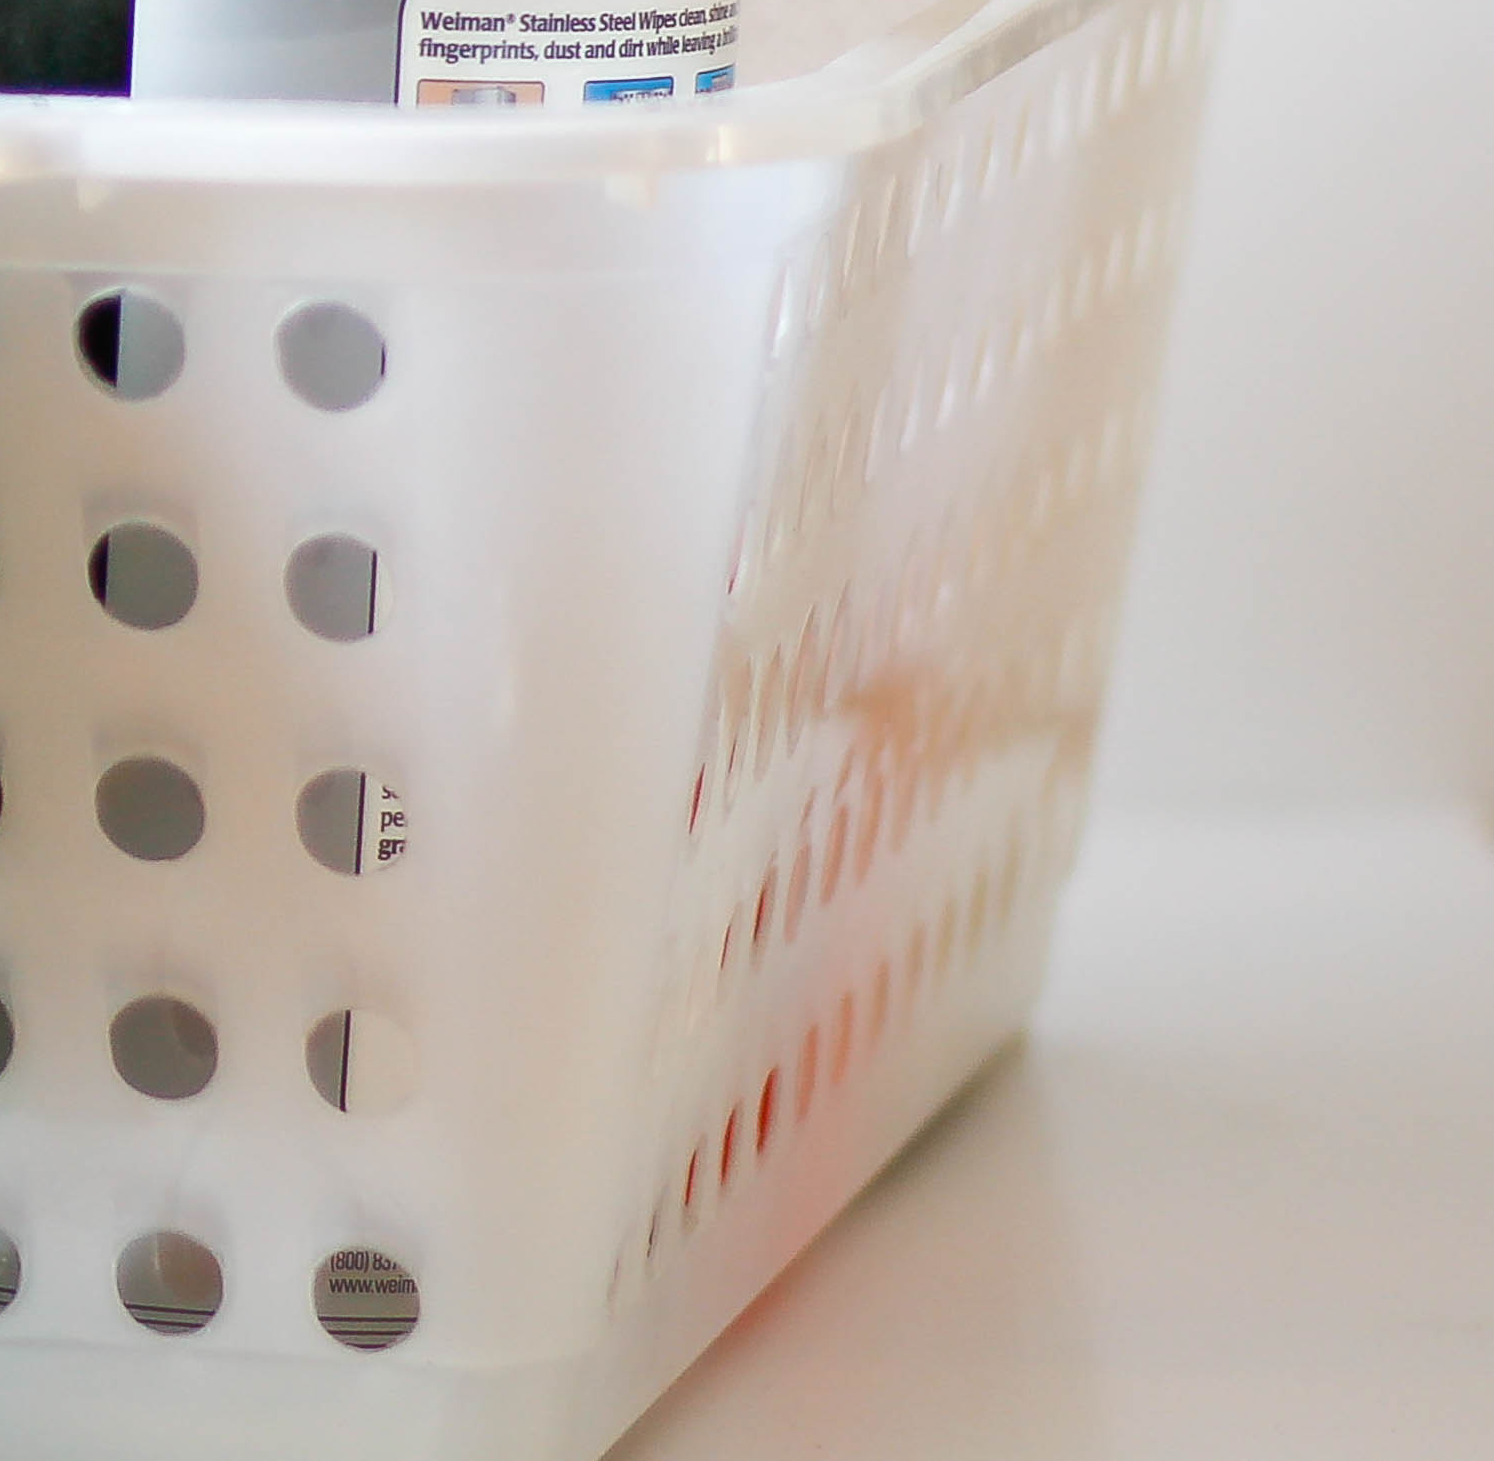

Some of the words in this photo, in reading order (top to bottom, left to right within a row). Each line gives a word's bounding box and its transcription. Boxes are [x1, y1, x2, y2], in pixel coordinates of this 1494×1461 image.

[519, 13, 596, 32] Stainless
[598, 12, 636, 32] Steel
[639, 10, 677, 34] Wipes
[679, 8, 707, 27] clean,
[419, 38, 539, 64] fingerprints,
[544, 41, 581, 59] dust
[585, 40, 615, 59] and
[619, 38, 644, 57] dirt
[647, 36, 680, 56] while
[681, 31, 715, 55] leaving
[716, 32, 722, 47] a
[331, 1251, 369, 1273] (800)
